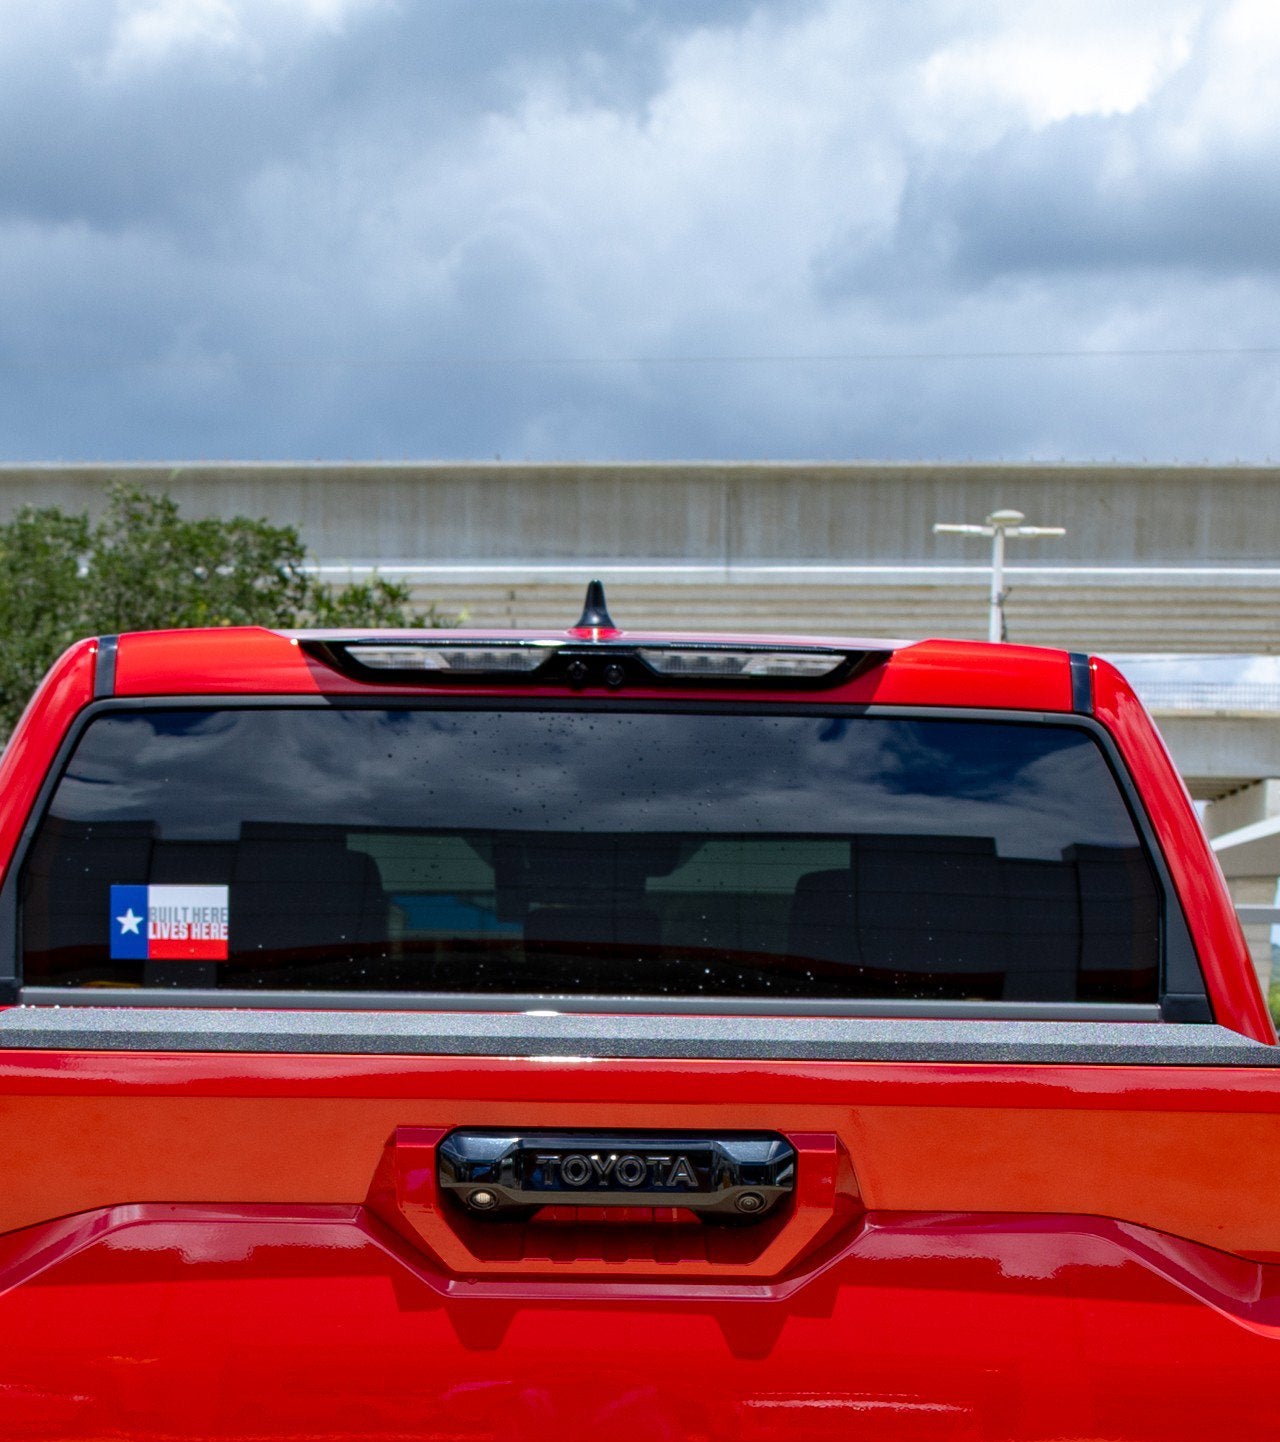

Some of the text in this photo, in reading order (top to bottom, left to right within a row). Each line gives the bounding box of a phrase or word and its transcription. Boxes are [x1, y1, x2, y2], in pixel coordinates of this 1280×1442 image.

[149, 907, 228, 923] BUILT HERE
[148, 923, 228, 940] LIVES HERE
[535, 1153, 700, 1187] TOYOTA
